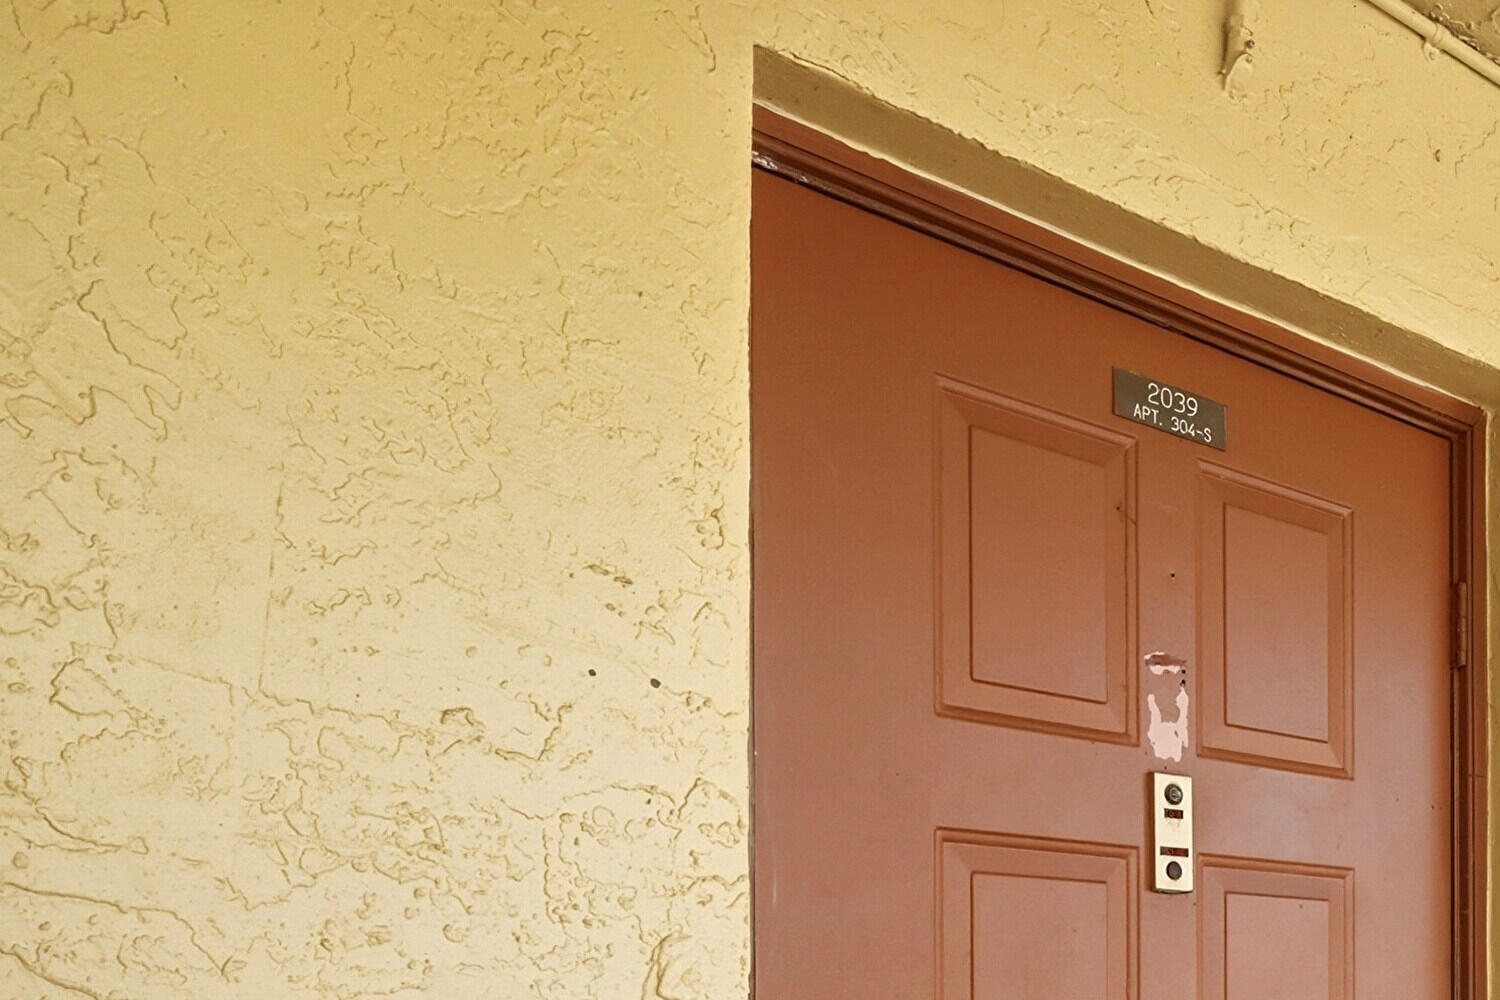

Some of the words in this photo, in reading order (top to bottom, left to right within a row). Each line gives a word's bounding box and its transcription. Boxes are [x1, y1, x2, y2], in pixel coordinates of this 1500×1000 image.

[1148, 382, 1198, 416] 2039
[1133, 403, 1163, 426] APT.
[1170, 416, 1212, 443] 304-S
